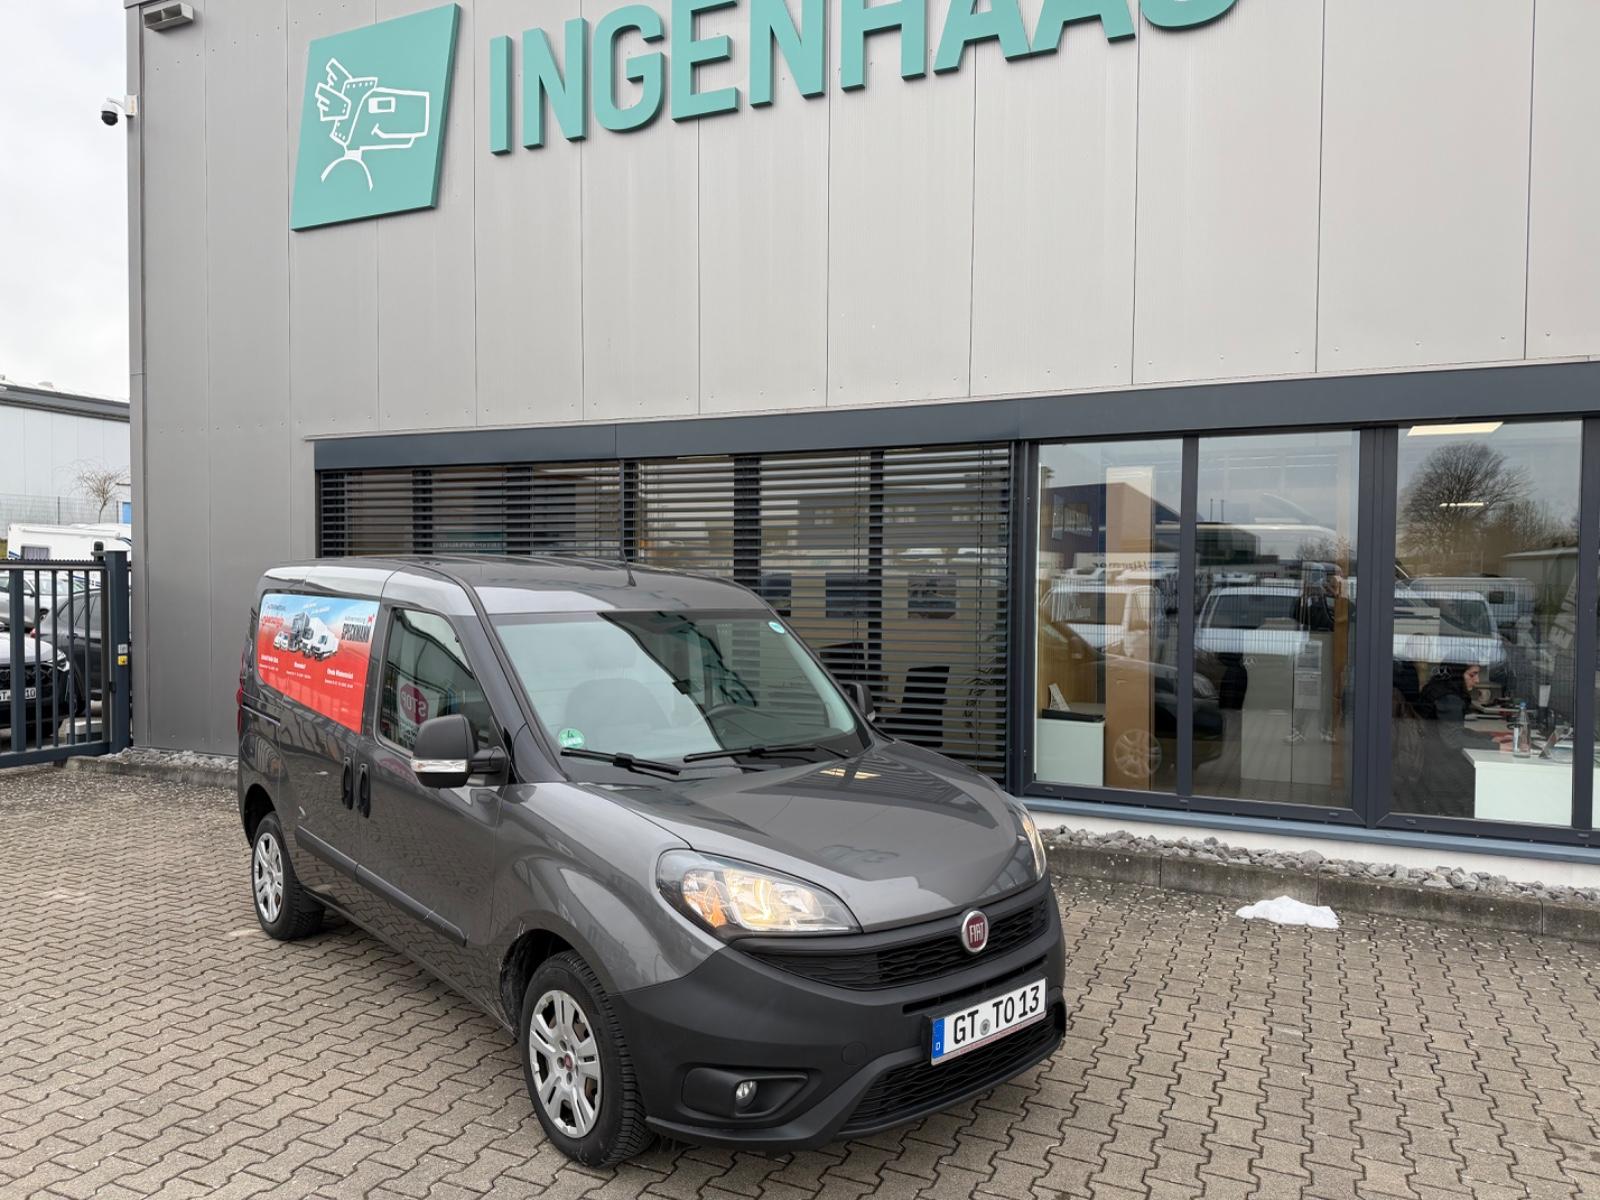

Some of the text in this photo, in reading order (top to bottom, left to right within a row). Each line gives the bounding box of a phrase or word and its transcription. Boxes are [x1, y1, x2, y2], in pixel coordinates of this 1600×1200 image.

[489, 0, 1238, 155] INGENHAA
[969, 922, 984, 943] FIAT
[954, 1009, 979, 1045] GT
